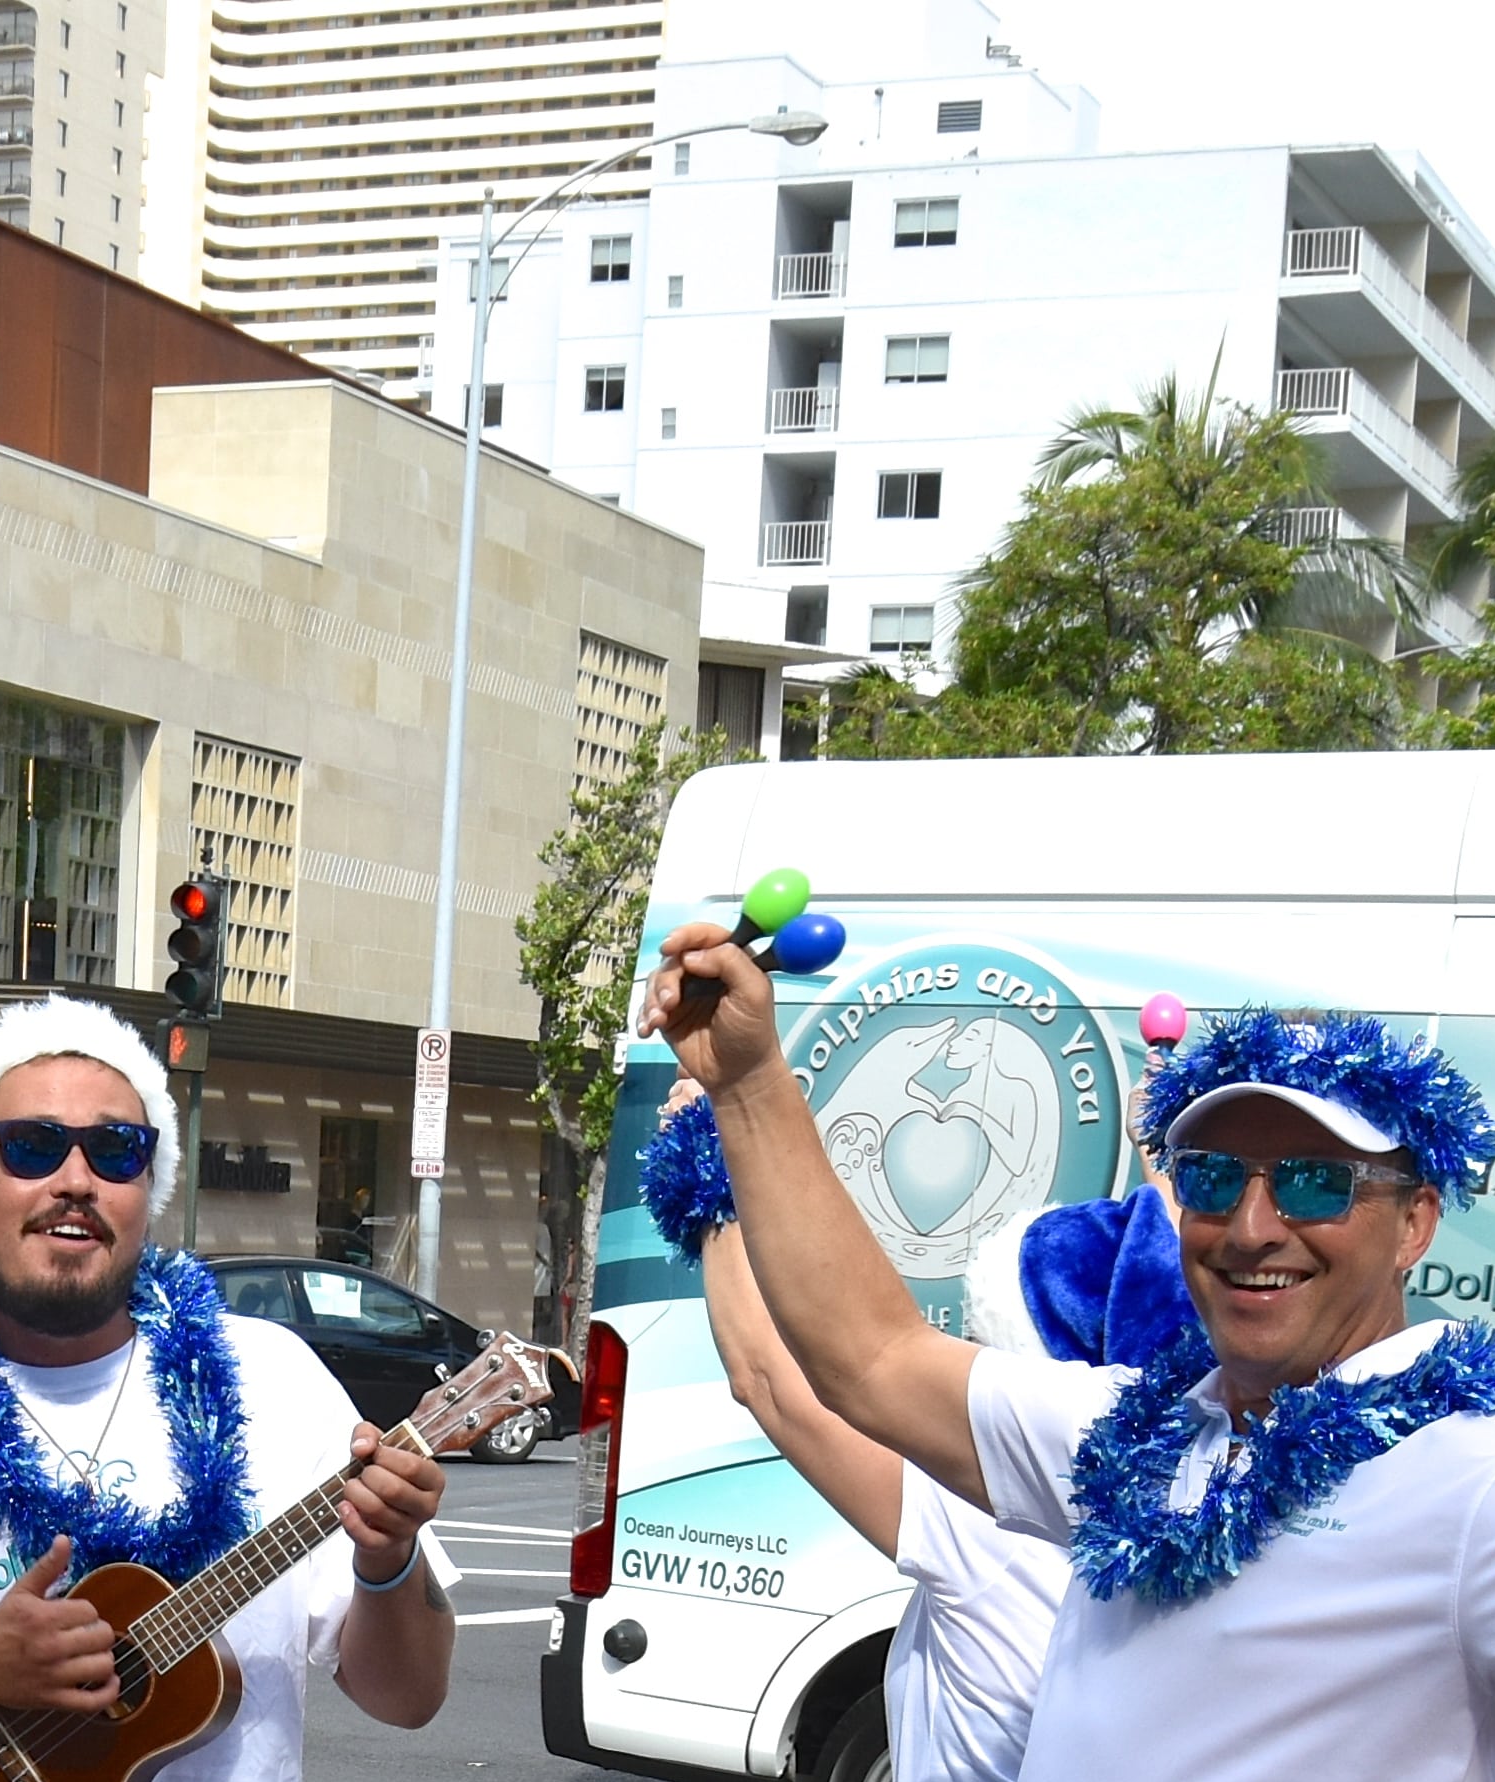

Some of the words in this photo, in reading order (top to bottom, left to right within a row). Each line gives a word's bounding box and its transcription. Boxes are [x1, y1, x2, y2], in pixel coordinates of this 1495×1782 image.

[976, 966, 1058, 1025] and
[1060, 1022, 1101, 1126] You
[415, 1162, 441, 1174] BEGIN
[624, 1516, 675, 1540] Ocean
[678, 1524, 754, 1554] Journeys
[757, 1534, 789, 1556] LLC
[621, 1548, 692, 1585] GVW
[697, 1559, 785, 1599] 10,360
